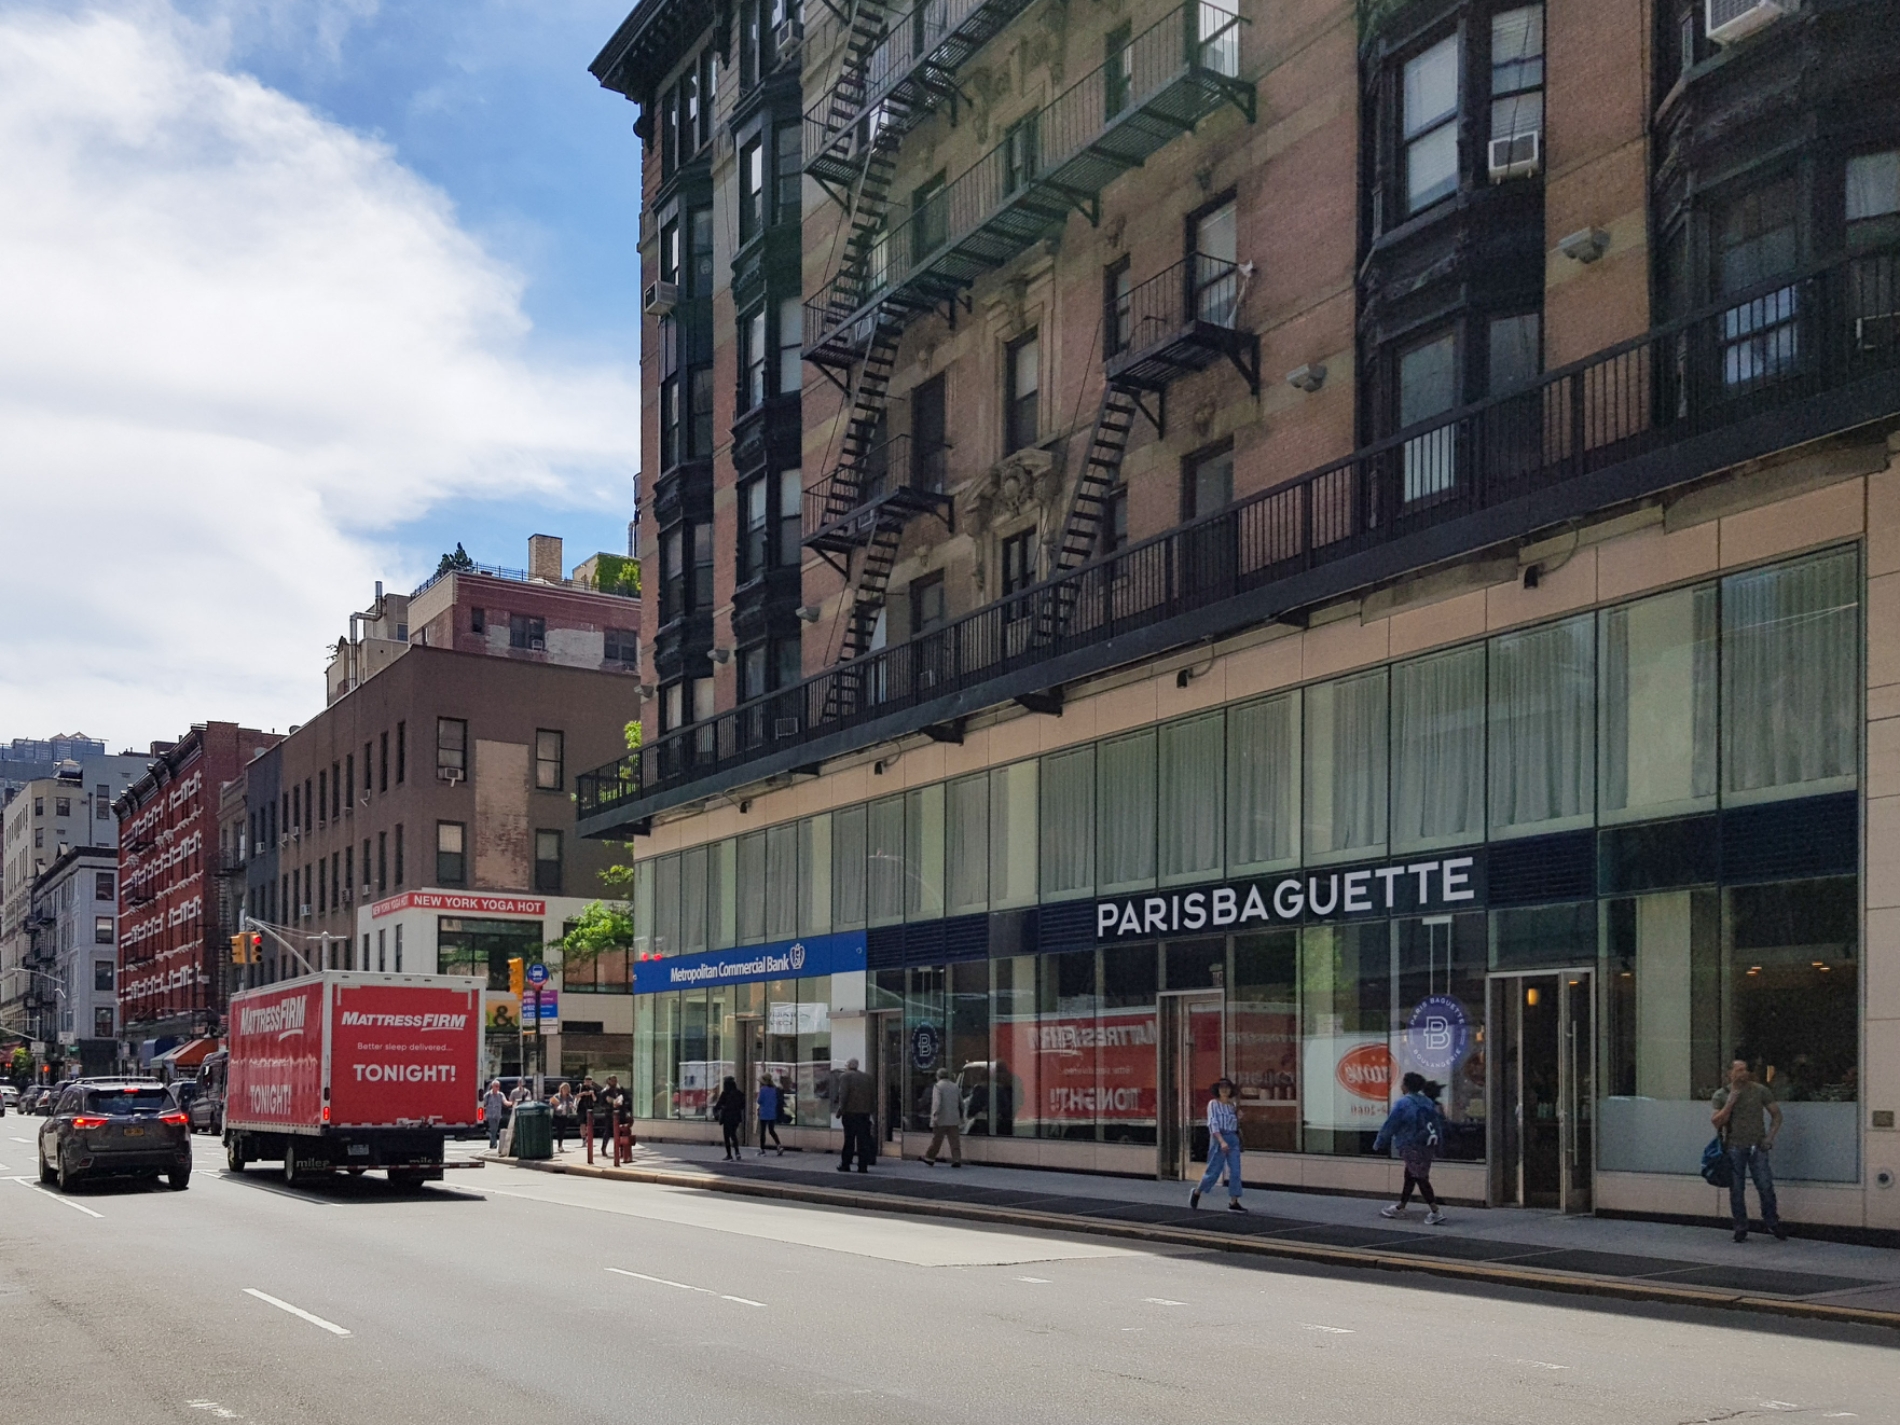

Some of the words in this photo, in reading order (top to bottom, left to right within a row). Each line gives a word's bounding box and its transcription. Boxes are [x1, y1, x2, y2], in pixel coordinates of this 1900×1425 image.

[414, 894, 442, 906] NEW
[446, 897, 478, 909] YORK
[482, 899, 514, 912] YOGA
[518, 901, 542, 913] HOT
[670, 963, 718, 984] Metropolitan
[718, 957, 766, 977] Commercial
[766, 953, 789, 971] Bank
[1410, 1001, 1428, 1026] PARIS
[1430, 997, 1465, 1025] BAGUETTE
[357, 1041, 383, 1050] Better
[385, 1043, 407, 1052] sleep
[1413, 1048, 1461, 1068] BOULANGERIE
[353, 1064, 456, 1082] TONIGHT!
[250, 1084, 292, 1115] TONIGHT!
